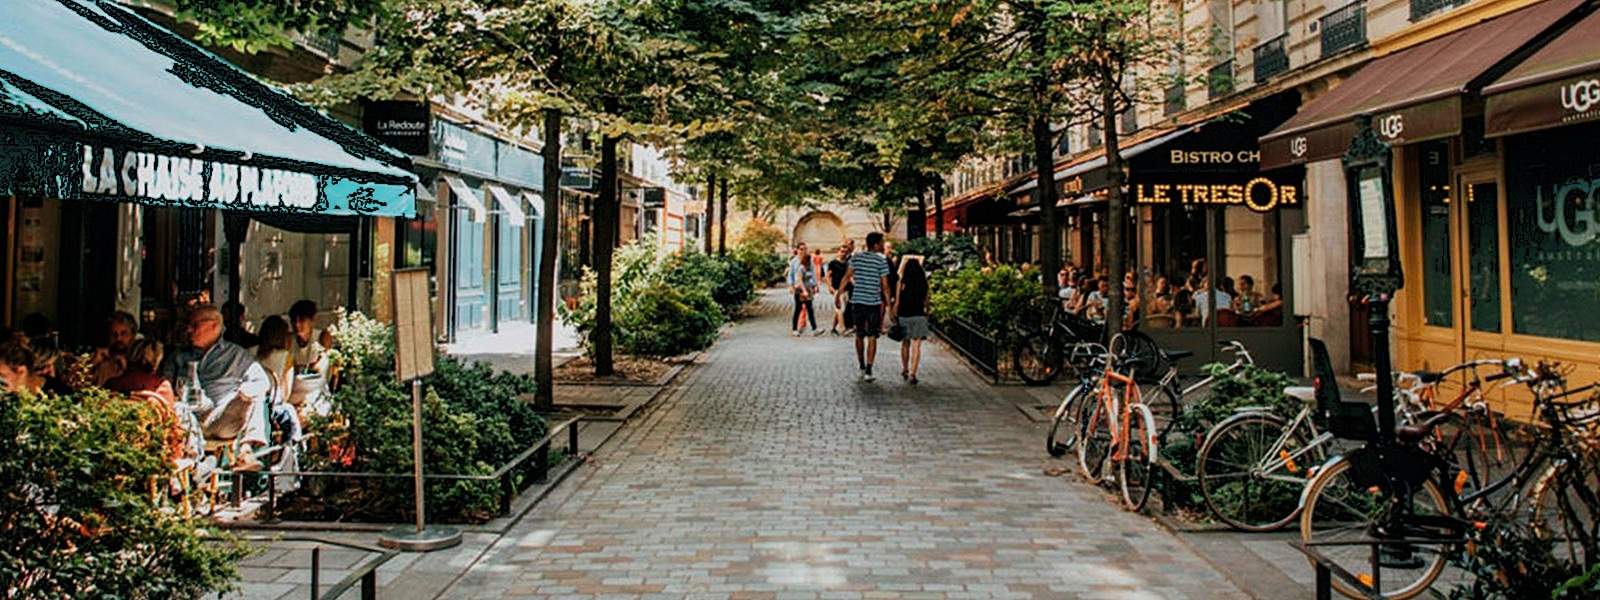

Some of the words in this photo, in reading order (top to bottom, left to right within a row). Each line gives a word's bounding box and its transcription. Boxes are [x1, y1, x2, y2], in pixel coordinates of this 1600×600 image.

[1561, 79, 1600, 112] UGG
[377, 119, 387, 130] La
[388, 119, 426, 130] Redoute
[1380, 114, 1404, 138] UGG
[1290, 136, 1308, 157] UGG
[81, 144, 118, 195] LA
[121, 151, 204, 201] CHAISE
[208, 161, 239, 204] AU
[1137, 183, 1171, 203] LE
[1176, 176, 1297, 212] TRESOR
